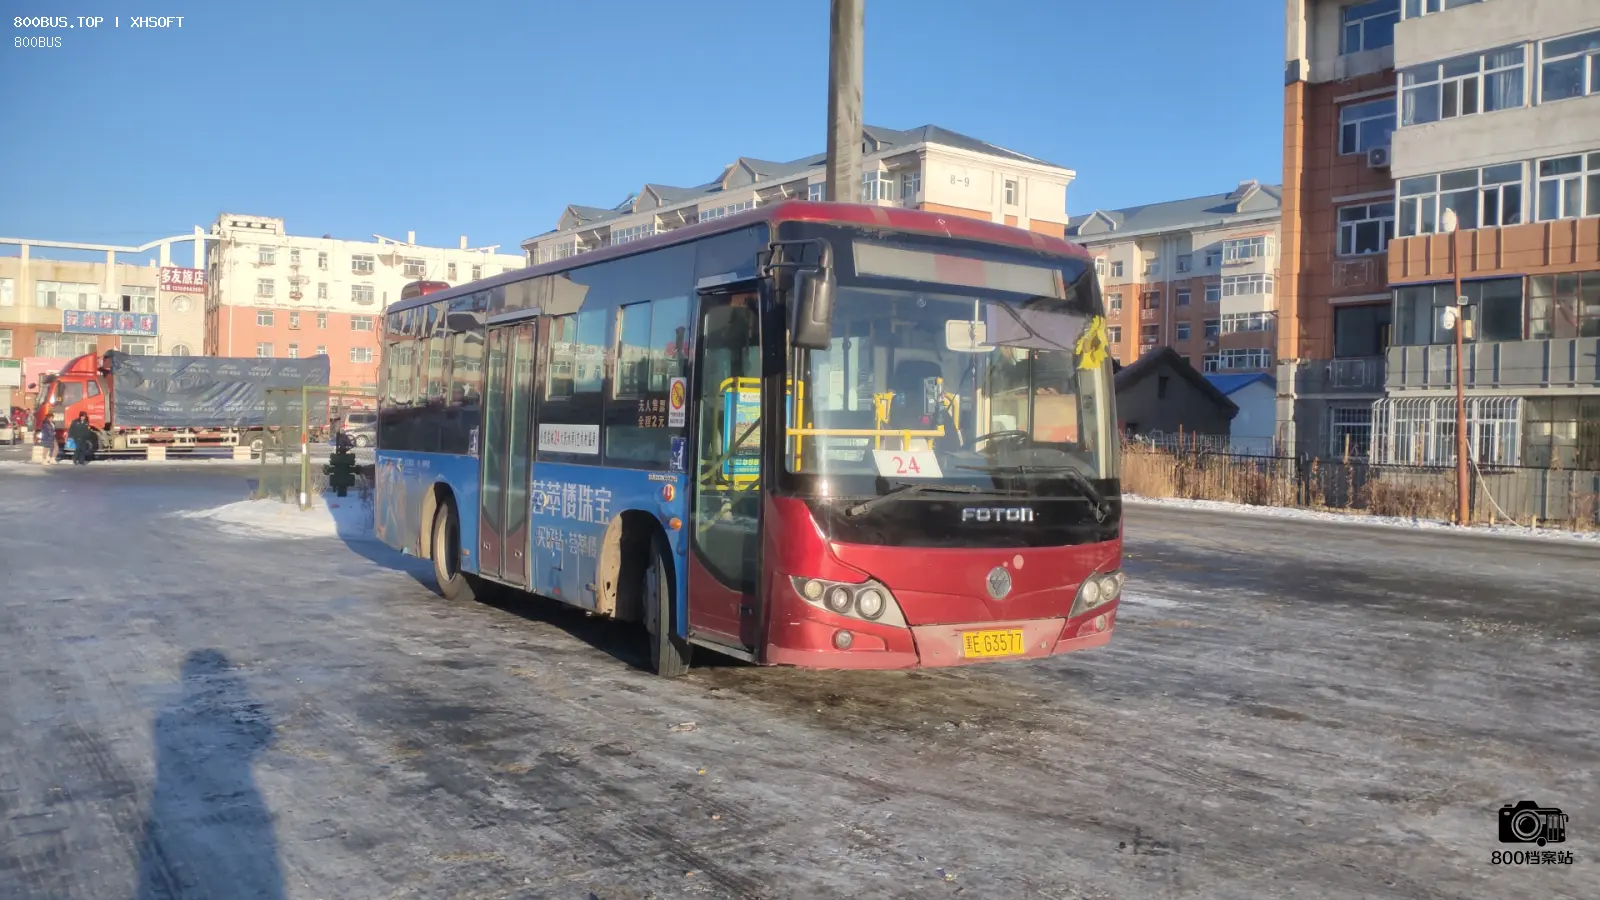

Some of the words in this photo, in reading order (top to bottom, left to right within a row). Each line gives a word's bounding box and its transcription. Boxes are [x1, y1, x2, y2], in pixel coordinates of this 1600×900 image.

[161, 267, 204, 286] 多友旅店
[638, 399, 666, 413] 无人售票
[638, 415, 665, 429] 全程2元
[892, 456, 921, 474] 24
[962, 507, 1034, 523] FOTON
